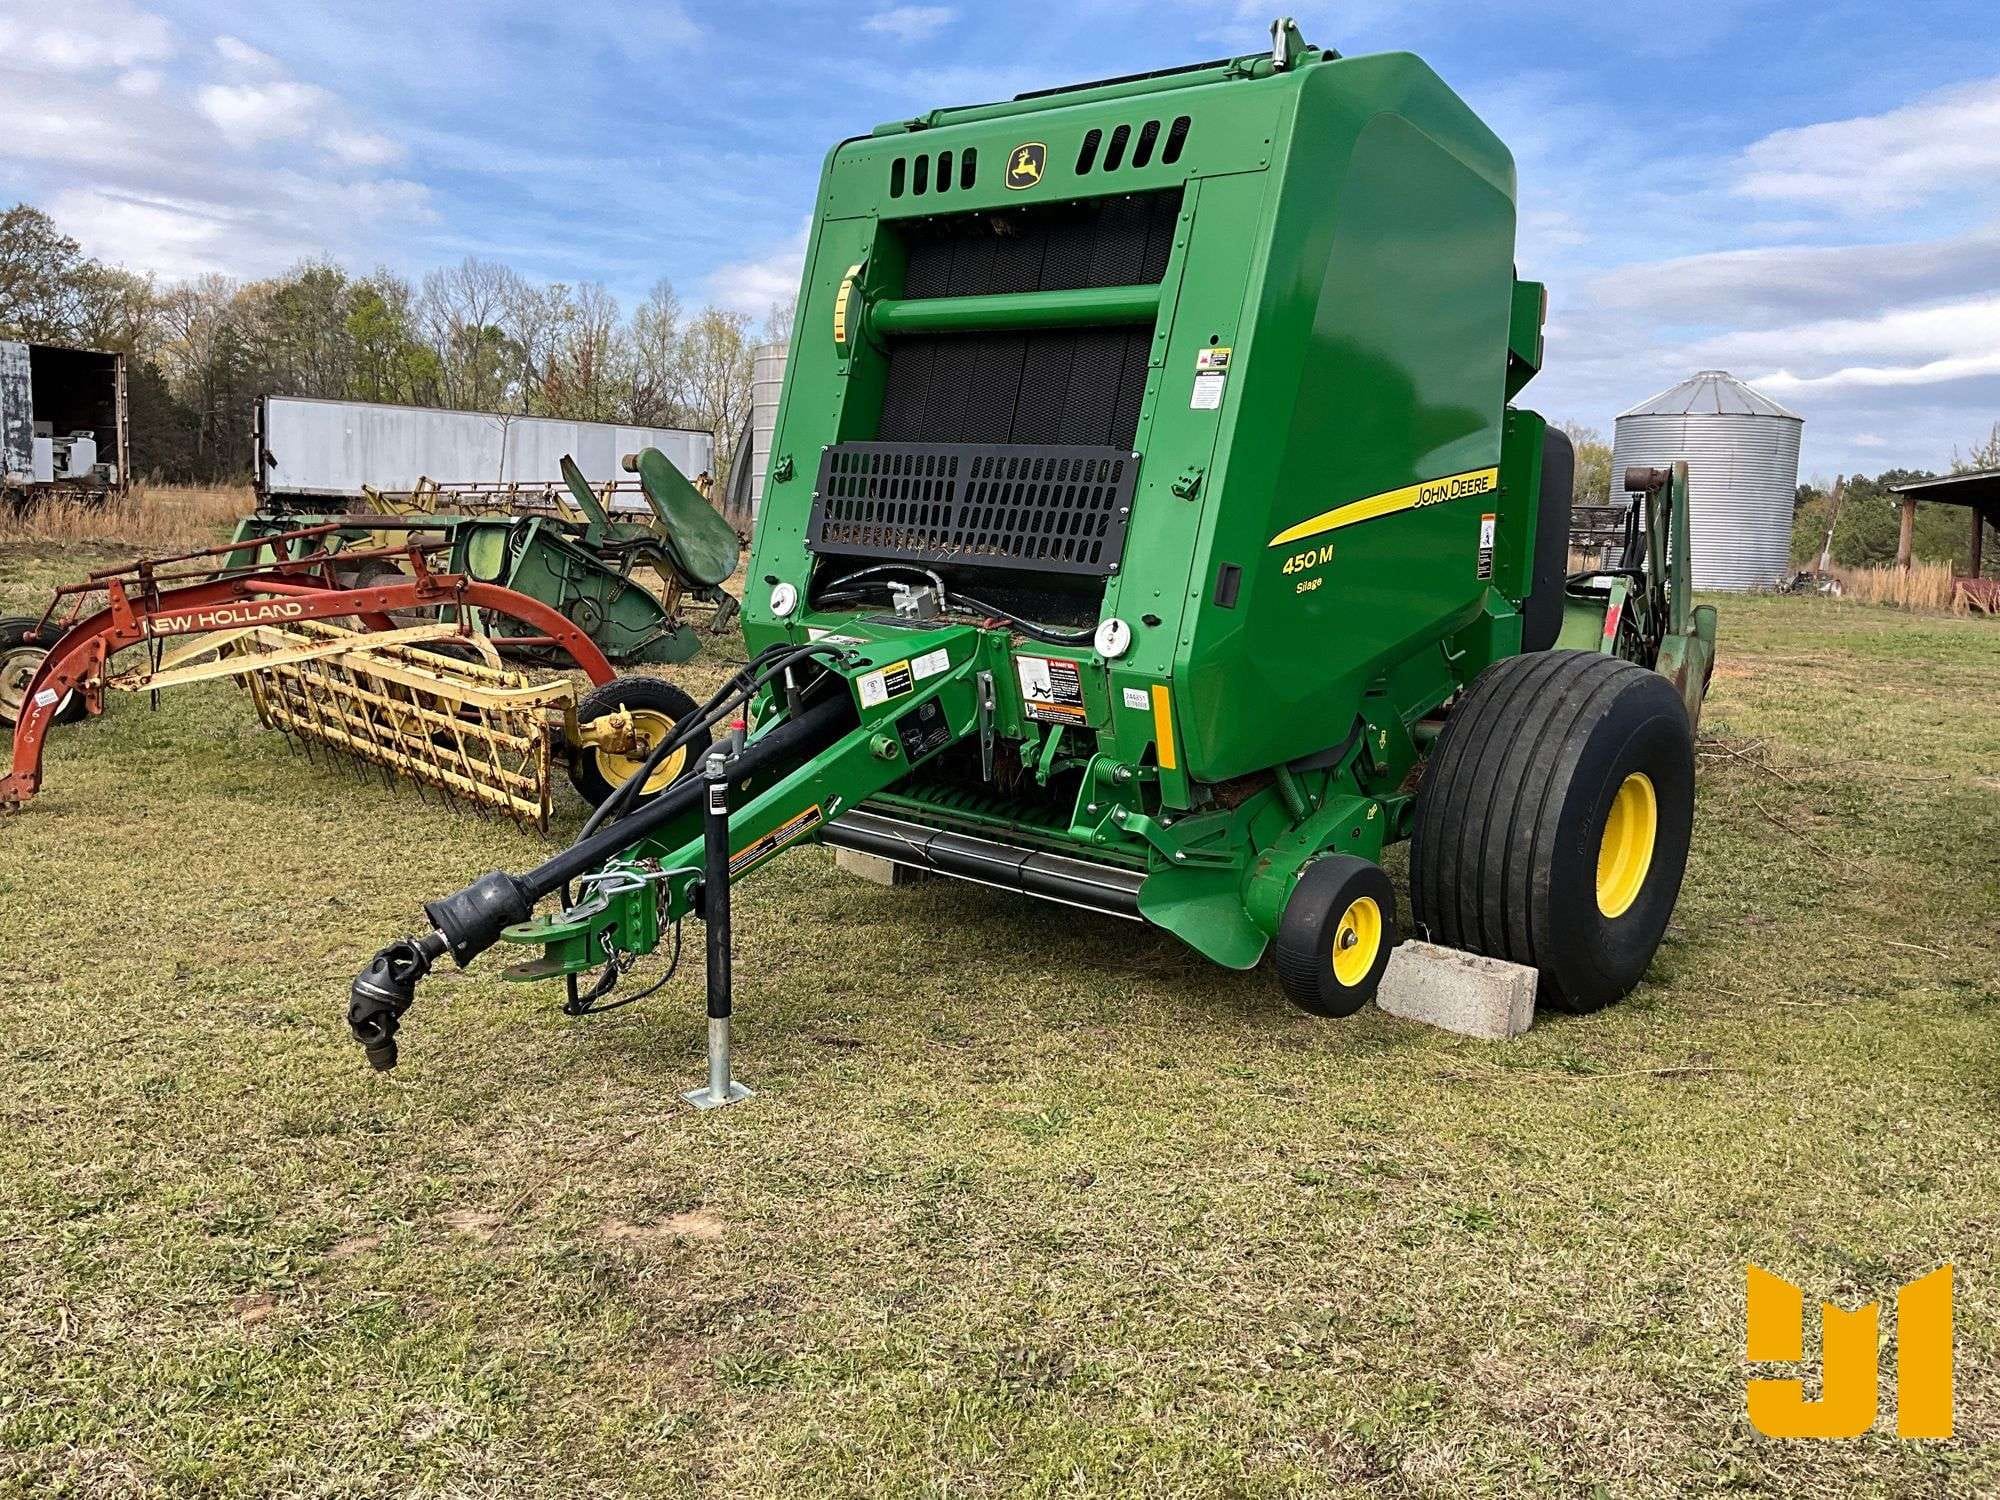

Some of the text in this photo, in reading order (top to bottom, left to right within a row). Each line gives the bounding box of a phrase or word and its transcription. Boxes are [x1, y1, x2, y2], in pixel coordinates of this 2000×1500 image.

[1414, 476, 1490, 508] JOHN DEERE
[1283, 544, 1335, 575] 450 M
[1296, 576, 1323, 594] Silage
[199, 602, 302, 627] HOLLAND
